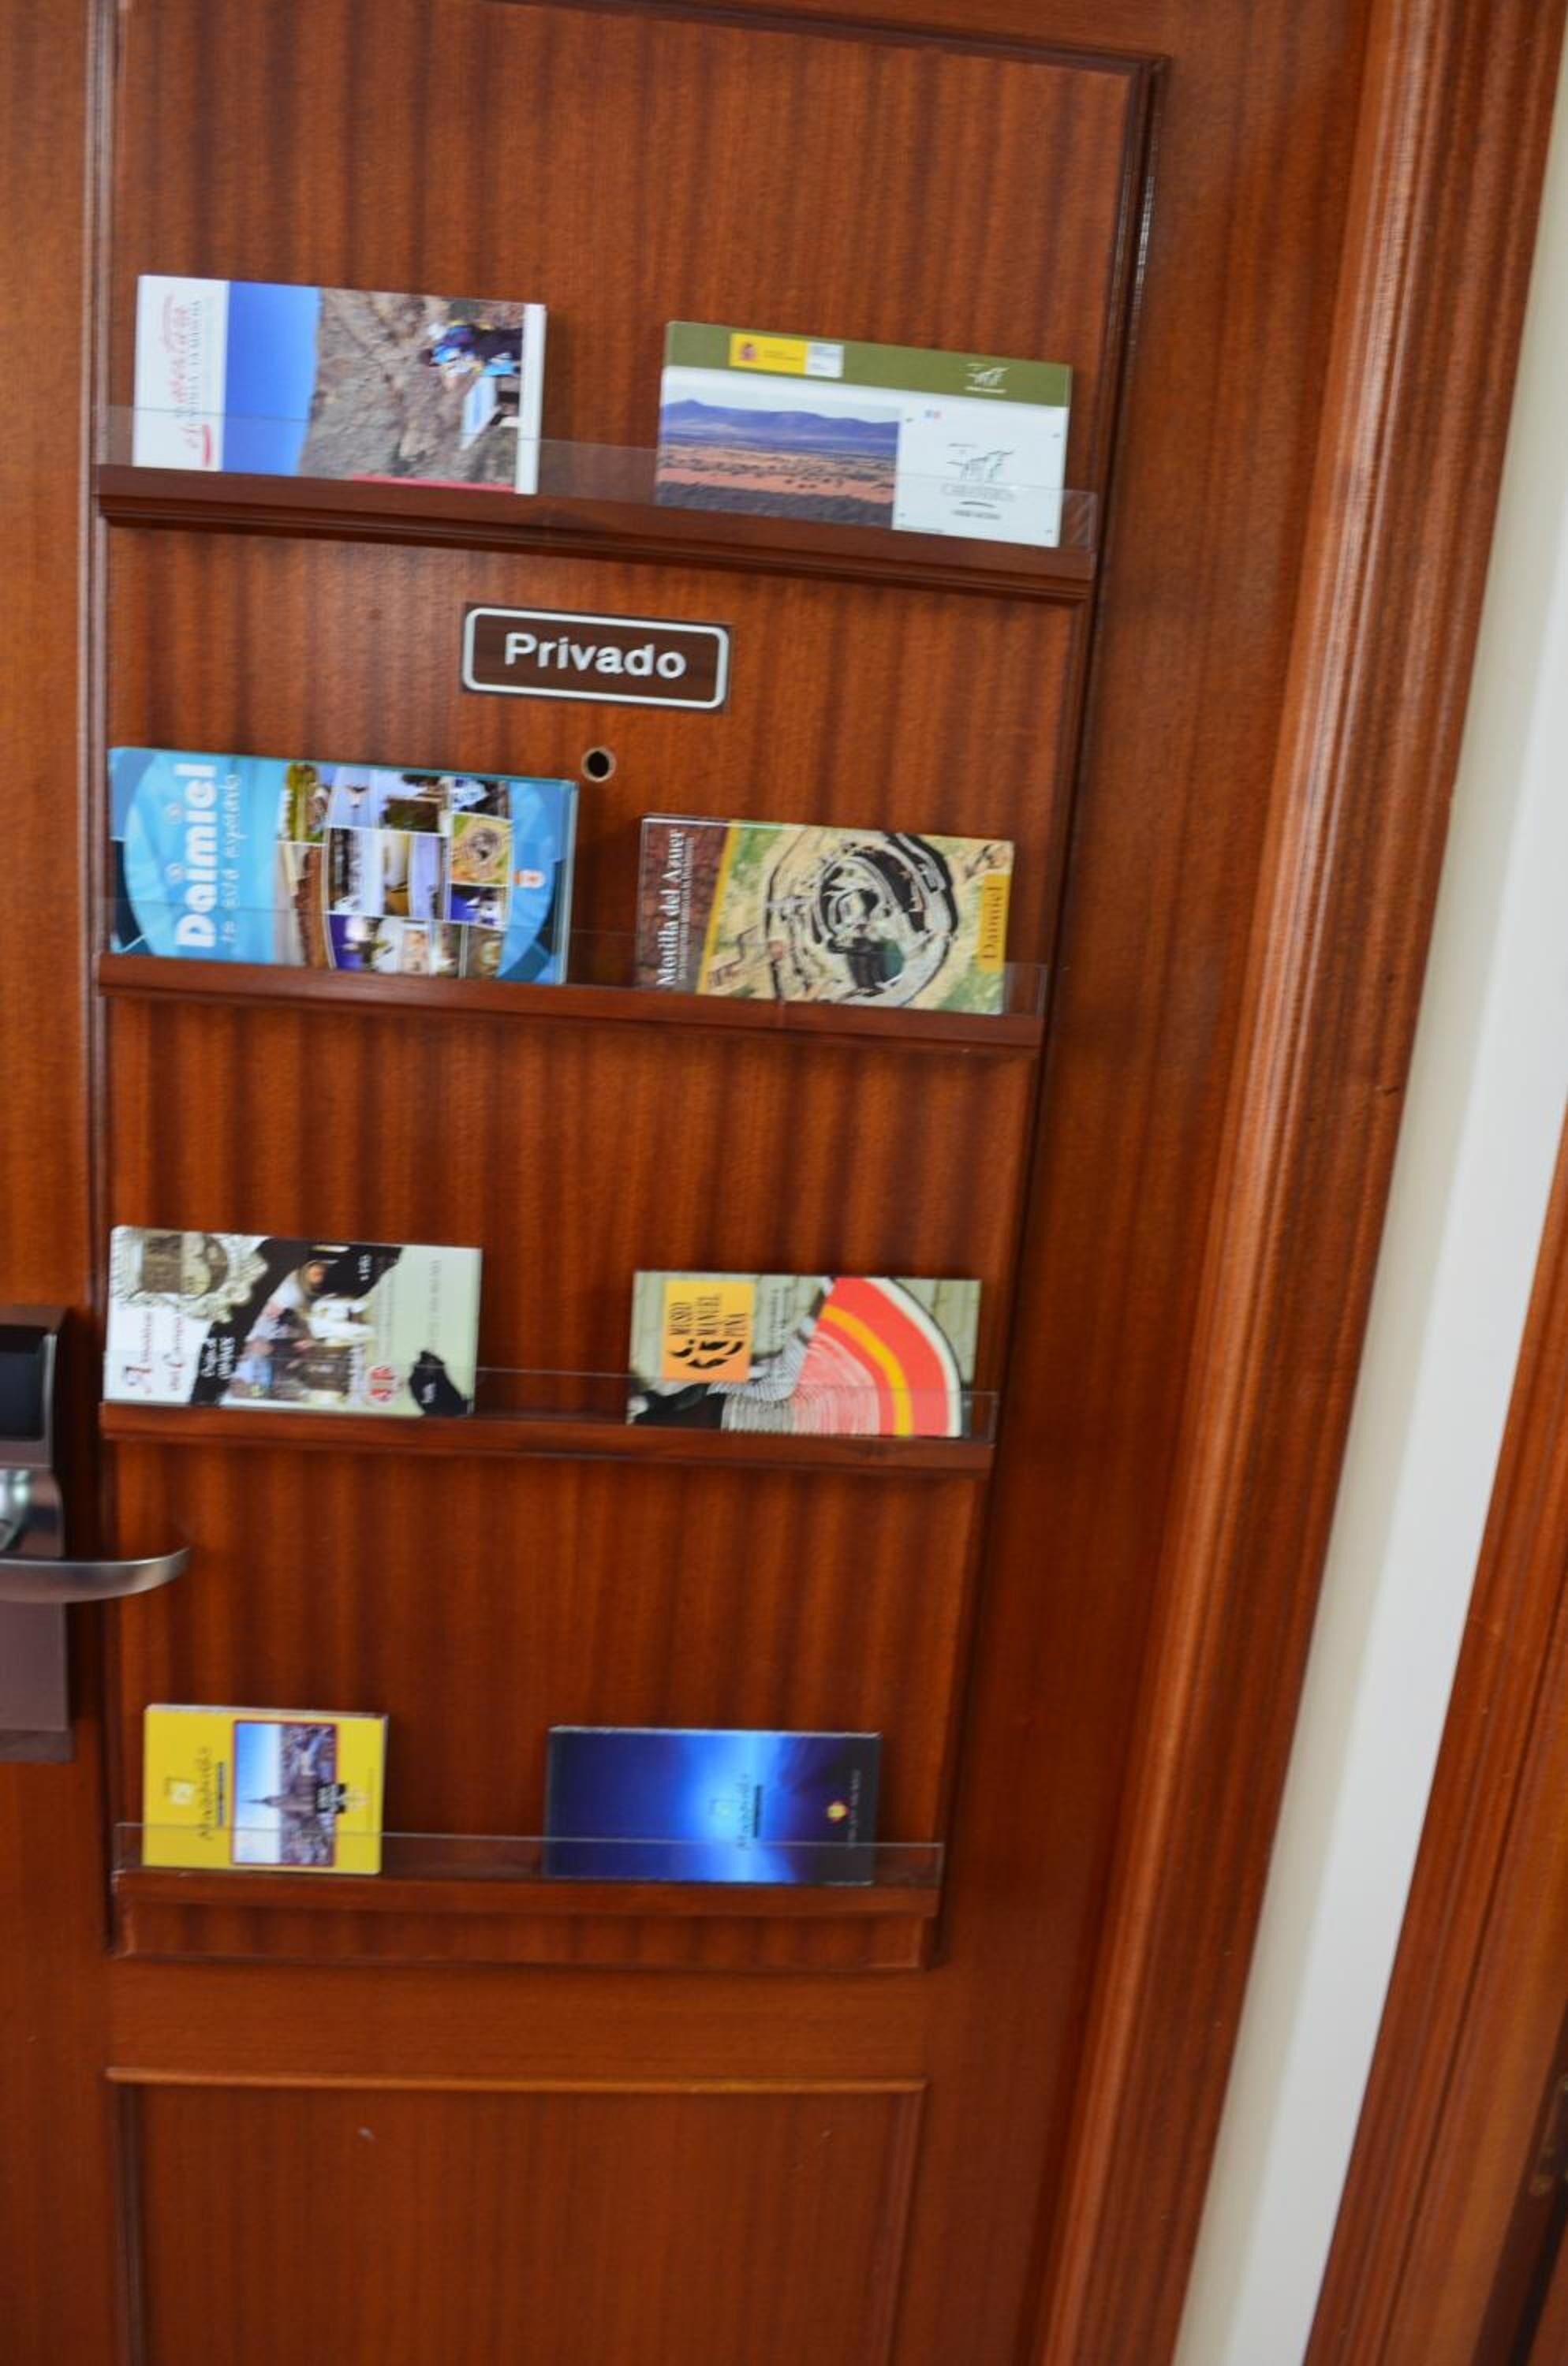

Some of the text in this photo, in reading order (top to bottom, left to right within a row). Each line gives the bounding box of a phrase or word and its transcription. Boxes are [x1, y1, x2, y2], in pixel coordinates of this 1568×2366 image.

[504, 632, 686, 679] Privado
[166, 762, 218, 948] Daimiel
[656, 830, 685, 986] Motilla del Azuer
